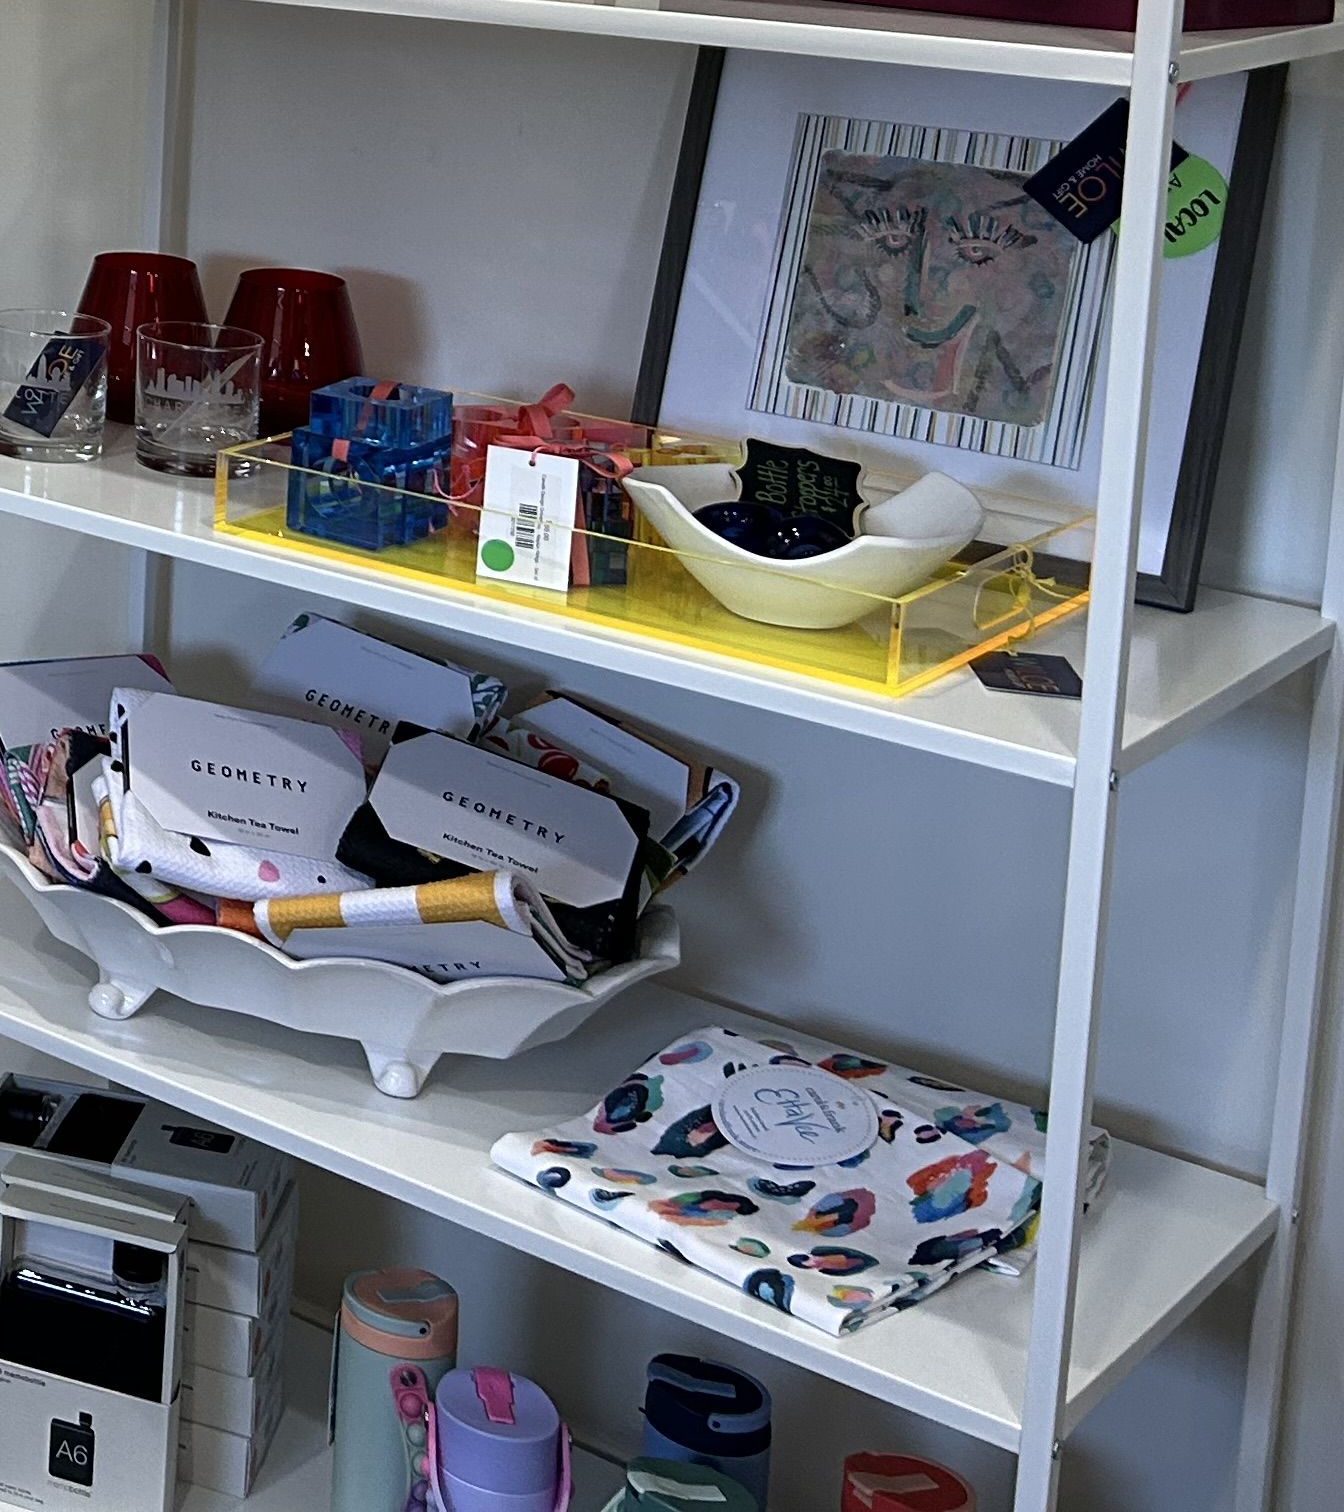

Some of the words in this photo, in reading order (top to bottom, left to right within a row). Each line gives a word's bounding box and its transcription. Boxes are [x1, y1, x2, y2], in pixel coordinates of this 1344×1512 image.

[1077, 154, 1102, 179] HOME
[1052, 183, 1071, 200] GIFT
[755, 460, 789, 504] Bottle
[305, 689, 391, 736] GEOMETR
[191, 759, 308, 793] GEOMETRY
[208, 810, 247, 825] Kitchen
[249, 818, 266, 829] Tea
[269, 822, 299, 835] Towel
[442, 791, 566, 845] GEOMETRY
[442, 832, 484, 853] Kitchen
[486, 848, 504, 861] Tea
[507, 856, 539, 874] Towel
[56, 1440, 88, 1466] A6
